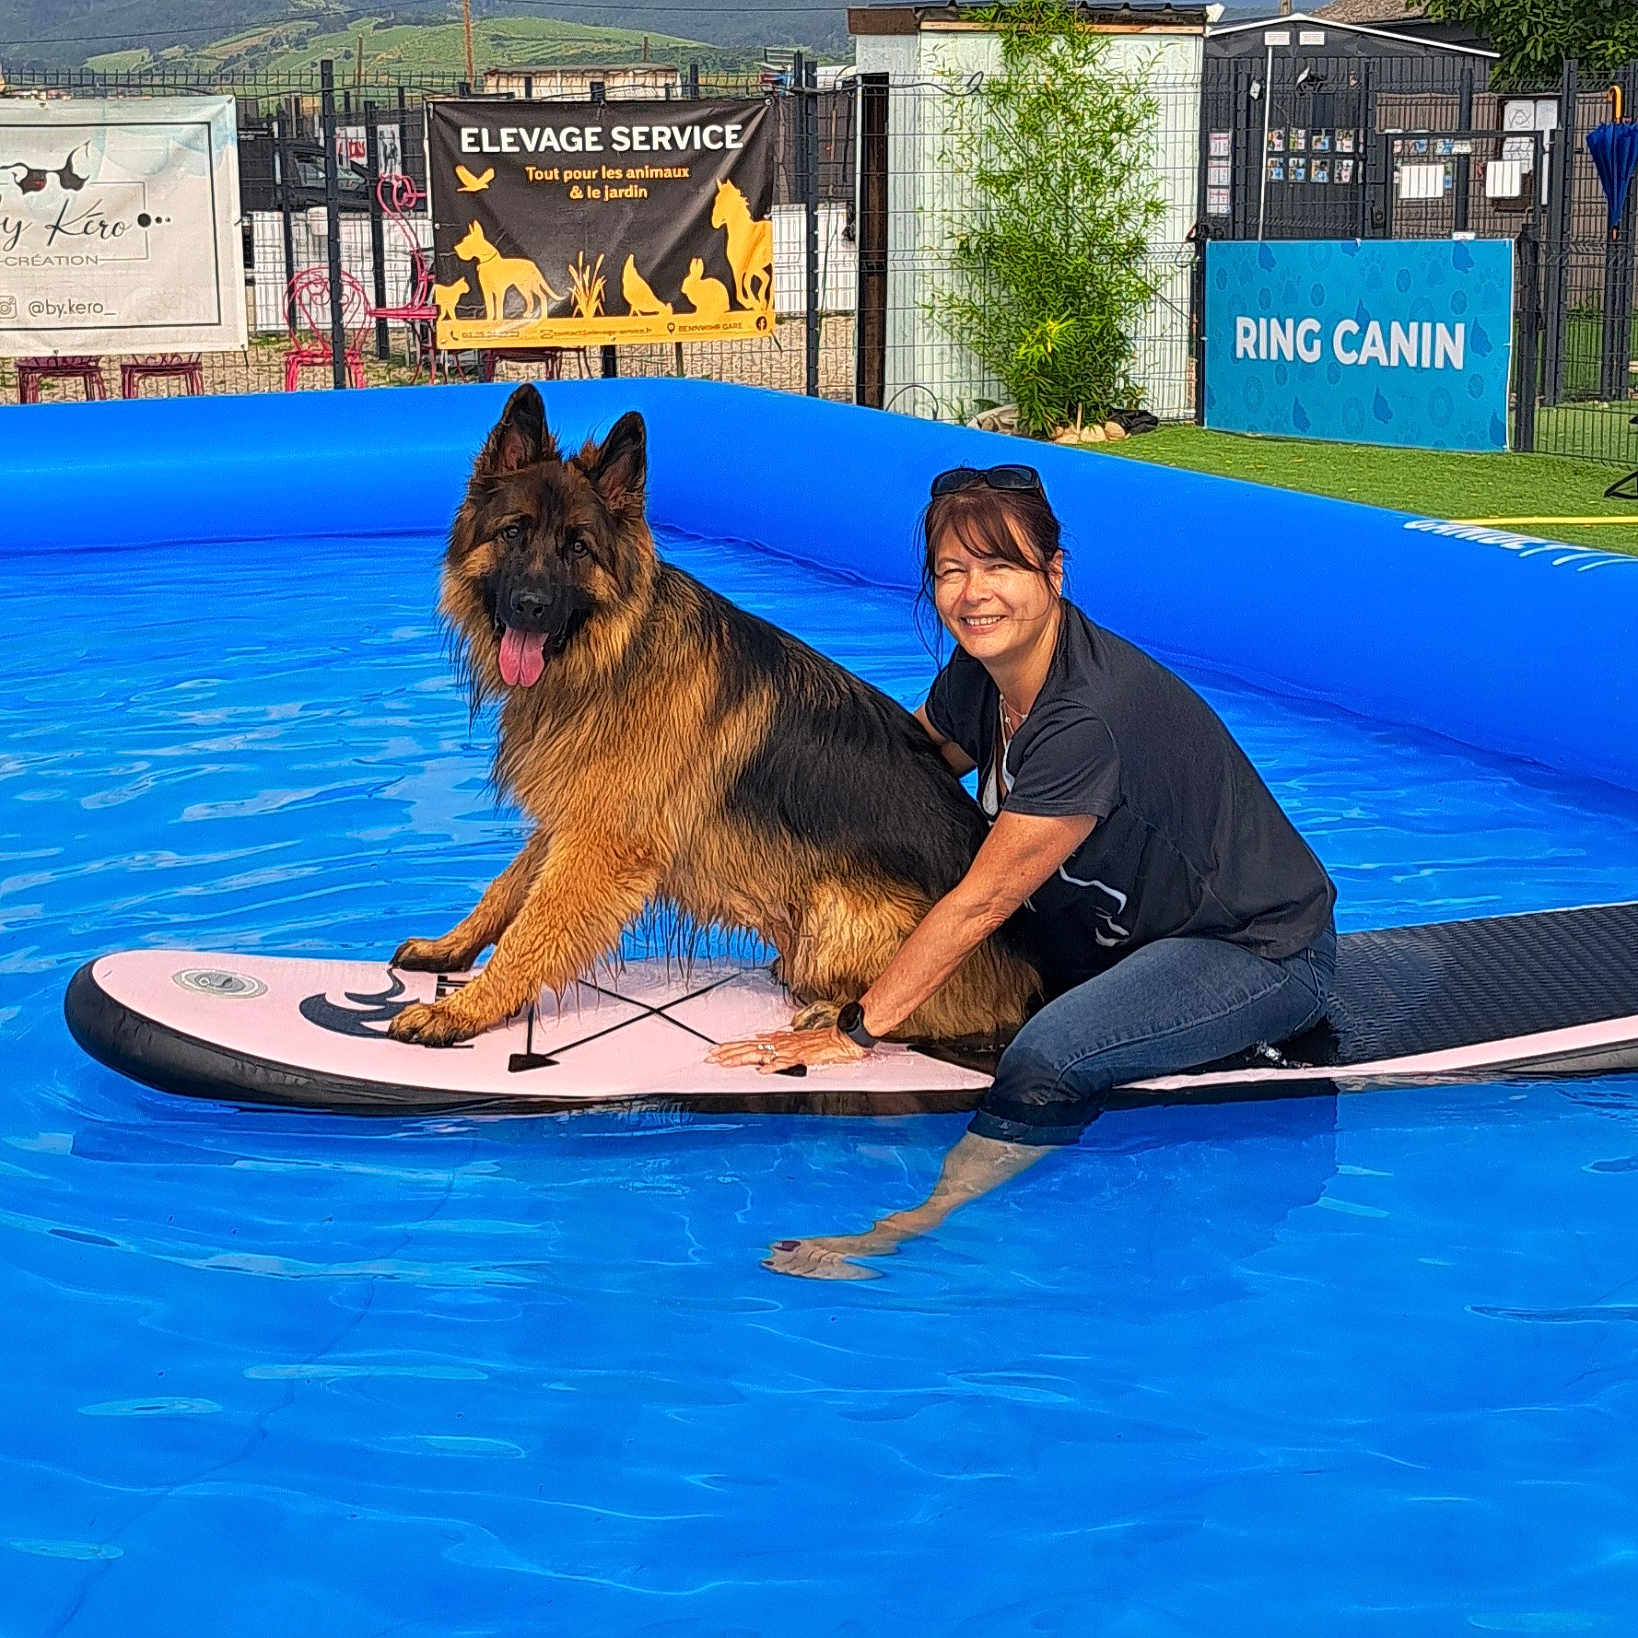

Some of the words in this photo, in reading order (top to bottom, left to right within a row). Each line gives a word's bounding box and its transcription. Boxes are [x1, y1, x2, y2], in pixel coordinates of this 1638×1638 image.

[460, 127, 604, 153] ELEVAGE
[611, 124, 744, 152] SERVICE
[525, 166, 559, 183] Tout
[563, 168, 598, 185] pour
[601, 166, 624, 181] les
[626, 164, 690, 180] animaux
[569, 186, 584, 200] &
[587, 184, 601, 199] le
[603, 183, 648, 202] jardin
[0, 216, 32, 251] y
[28, 299, 119, 319] @by.kero_
[1235, 316, 1322, 364] RING
[1332, 319, 1466, 370] CANIN
